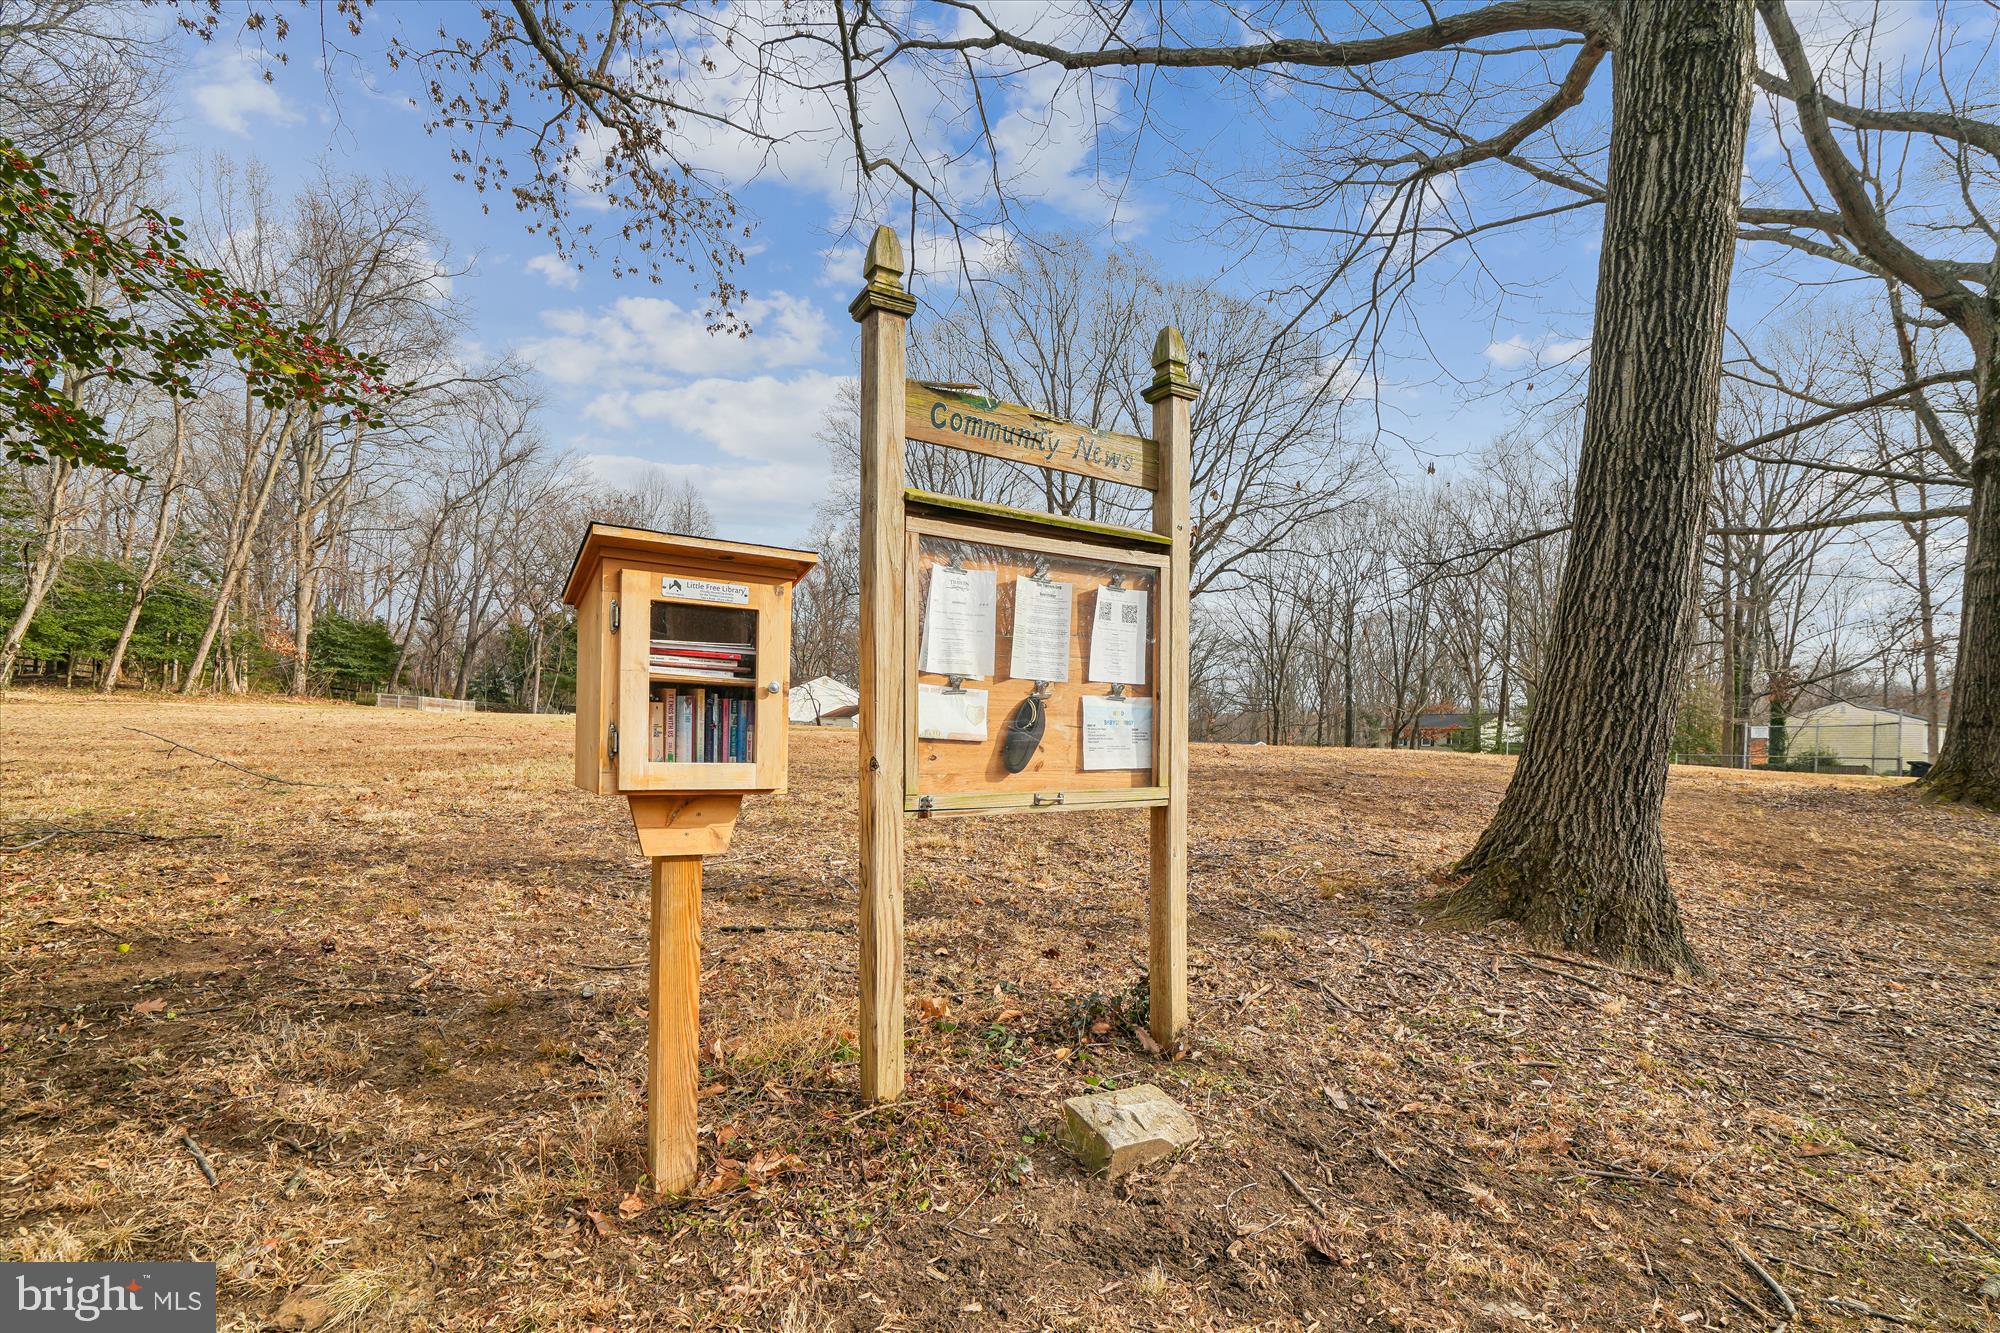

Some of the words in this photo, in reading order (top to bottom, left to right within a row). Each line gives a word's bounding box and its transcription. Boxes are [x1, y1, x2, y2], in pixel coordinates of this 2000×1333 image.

[930, 401, 1061, 460] Community
[1071, 434, 1135, 472] News
[686, 581, 705, 590] Little
[705, 583, 721, 592] Free
[722, 585, 746, 596] Library
